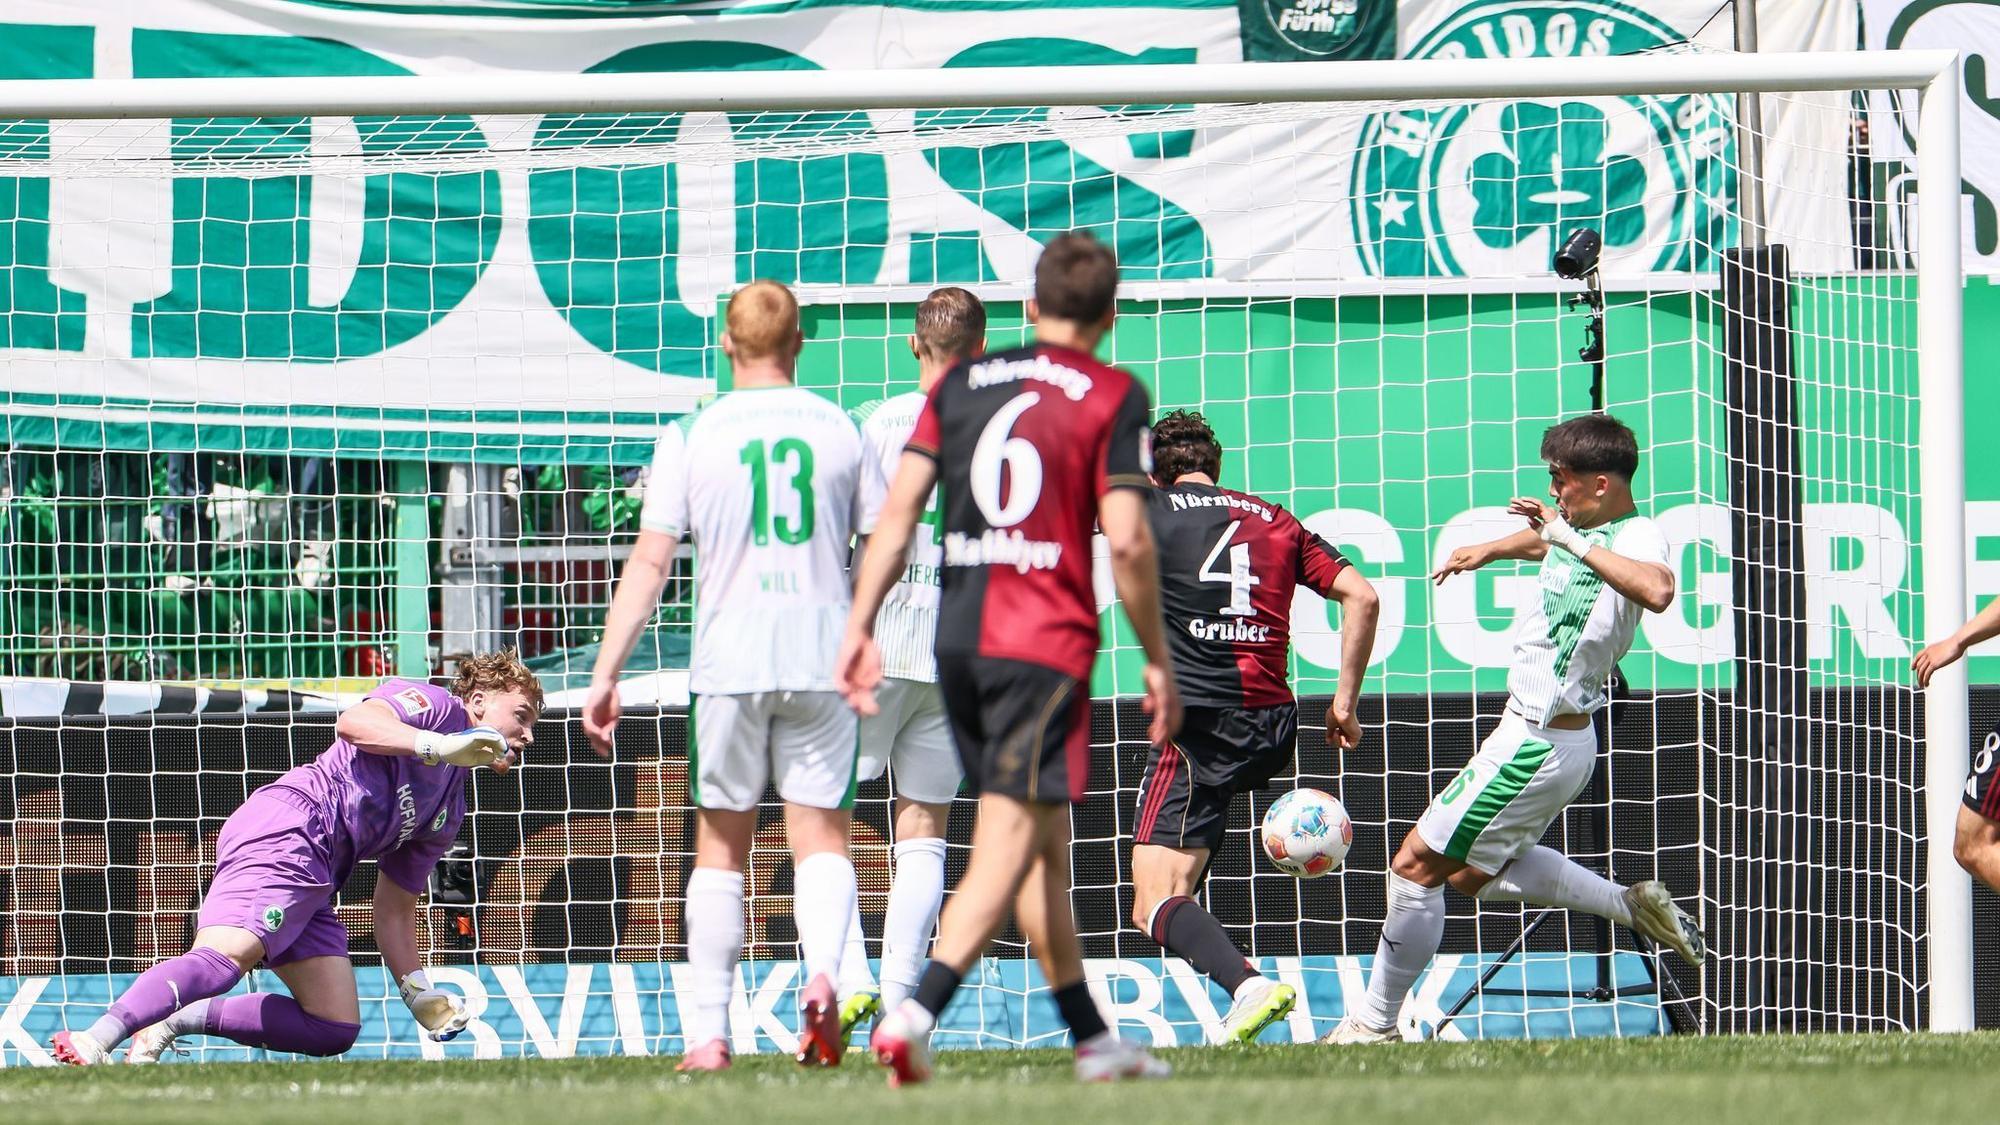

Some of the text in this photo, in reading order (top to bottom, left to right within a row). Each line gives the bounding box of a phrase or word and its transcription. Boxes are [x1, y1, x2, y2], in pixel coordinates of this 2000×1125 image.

[1280, 8, 1335, 33] Fürth
[968, 354, 1093, 401] Nürnberg
[970, 391, 1043, 528] 6
[739, 437, 815, 546] 13
[1168, 493, 1274, 523] Nürnberg
[757, 569, 802, 595] WILL
[1198, 519, 1261, 616] 4
[1188, 616, 1270, 643] Gruber
[1440, 768, 1475, 806] 6
